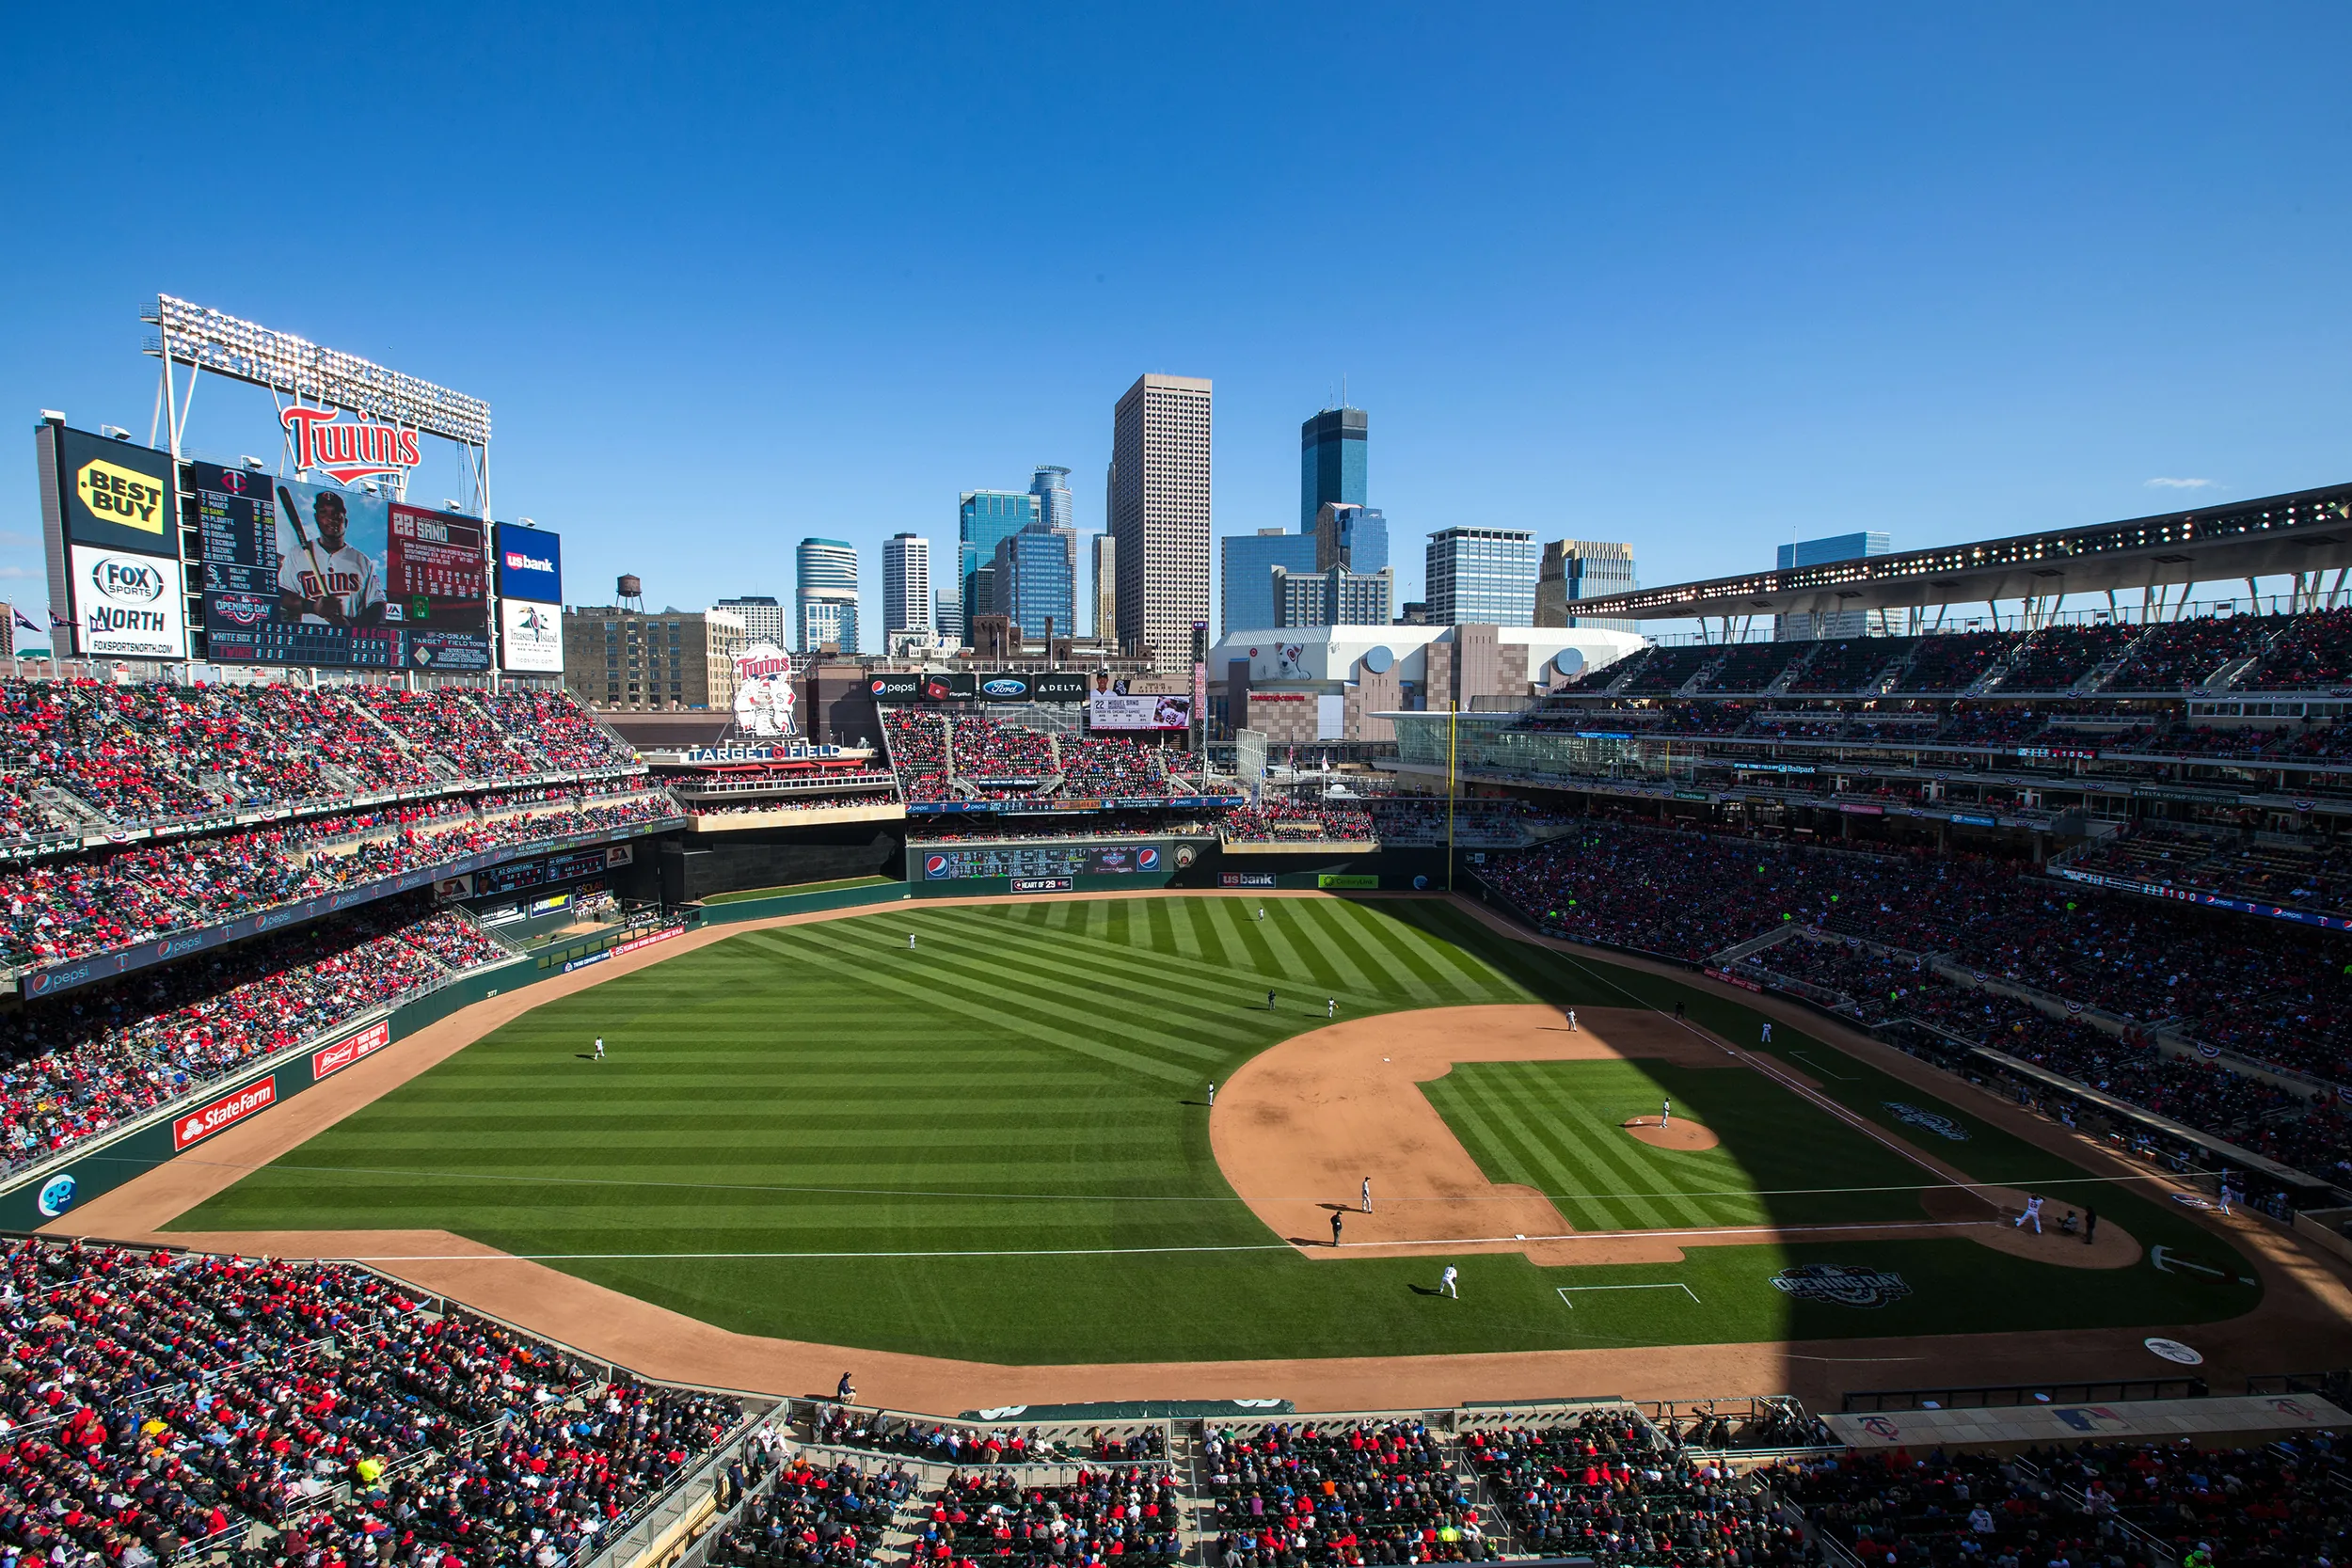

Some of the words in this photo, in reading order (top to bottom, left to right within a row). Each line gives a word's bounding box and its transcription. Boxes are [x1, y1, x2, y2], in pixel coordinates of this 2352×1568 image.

[280, 405, 421, 469] Twins
[89, 468, 161, 506] BEST
[208, 493, 229, 502] DOZIER
[93, 489, 156, 522] BUY
[209, 500, 229, 510] MAUER
[209, 508, 225, 516] SANO
[211, 515, 234, 526] PLOUFFE
[393, 512, 415, 536] 22
[417, 516, 446, 527] MIGUEL
[212, 531, 234, 540] ROSARIO
[417, 522, 448, 543] SANO
[212, 538, 236, 547] ESCOBAR
[213, 546, 232, 555] SUZUKI
[213, 553, 235, 562] BUXTON
[507, 553, 555, 573] usbank
[107, 563, 150, 588] FOX
[230, 567, 250, 576] ROLLINS
[108, 584, 151, 597] SPORTS
[215, 600, 254, 613] OPENING
[255, 604, 271, 613] DAY
[96, 606, 166, 631] NORTH
[211, 631, 235, 642] WHITE
[236, 634, 251, 642] SOX
[509, 628, 534, 641] Treasure
[540, 631, 558, 643] Island
[93, 640, 173, 654] FOXSPORTSNORTH.COM
[219, 646, 252, 658] TWINS
[736, 654, 789, 681] Twins
[887, 682, 916, 693] pepsi
[991, 681, 1018, 693] Ford
[1095, 700, 1104, 709] 22
[690, 746, 770, 763] TARGET
[789, 745, 842, 760] FIELD
[1788, 766, 1816, 774] Ballpark
[2187, 794, 2217, 803] LEGENDS
[155, 824, 184, 836] usbank
[186, 821, 203, 832] Home
[204, 819, 217, 831] Run
[217, 817, 233, 829] Porch
[644, 825, 653, 833] 90
[12, 845, 36, 858] Home
[38, 841, 56, 855] Run
[56, 839, 79, 851] Porch
[526, 840, 555, 850] QUINTANA
[506, 863, 533, 873] QUINTANA
[405, 875, 421, 887] pepsi
[1045, 880, 1057, 889] 29
[1223, 874, 1273, 884] usbank
[341, 892, 360, 905] pepsi
[532, 894, 569, 911] SUBWAY
[2215, 898, 2233, 907] pepsi
[268, 910, 291, 927] pepsi
[2281, 911, 2303, 919] pepsi
[173, 934, 203, 954] pepsi
[615, 946, 624, 956] 25
[624, 942, 634, 951] YEARS
[573, 959, 583, 969] TWINS
[583, 954, 602, 965] COMMUNITY
[53, 965, 89, 988] pepsi
[357, 1033, 371, 1045] THIS
[370, 1024, 386, 1039] BUD'S
[358, 1044, 369, 1055] FOR
[369, 1037, 381, 1051] YOU.
[322, 1047, 353, 1067] Budweiser
[43, 1180, 72, 1210] go
[1772, 1275, 1866, 1291] OPENING
[1860, 1273, 1904, 1289] DAY
